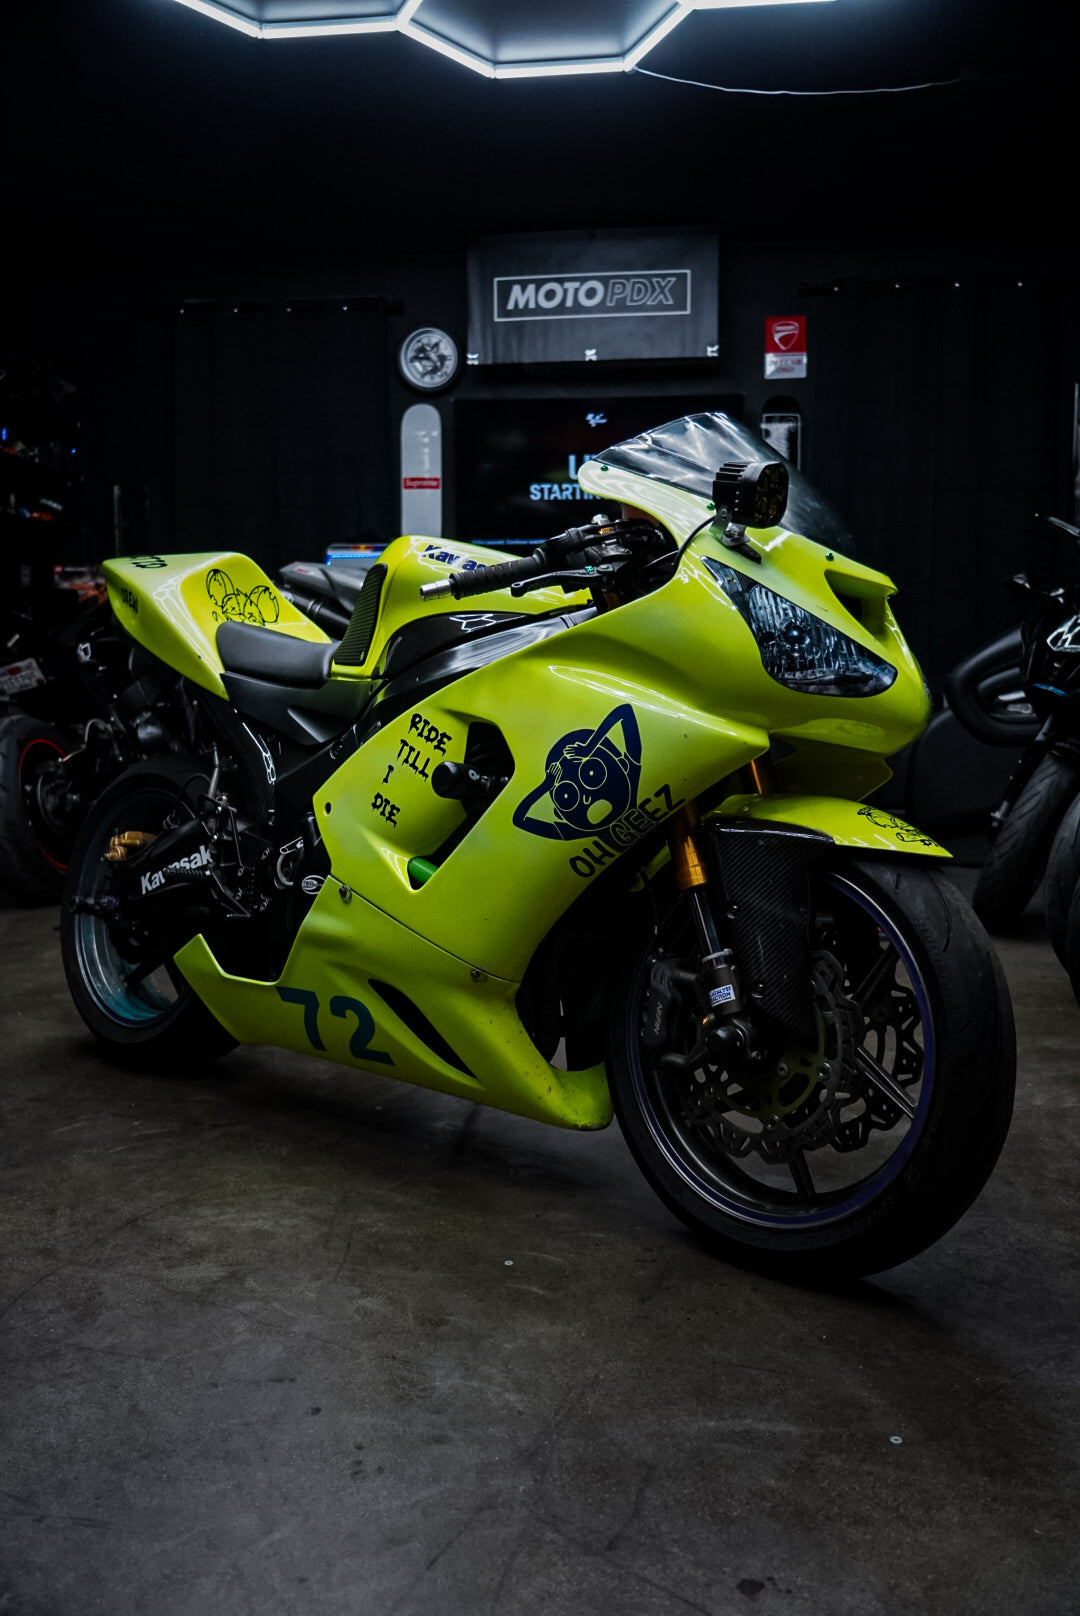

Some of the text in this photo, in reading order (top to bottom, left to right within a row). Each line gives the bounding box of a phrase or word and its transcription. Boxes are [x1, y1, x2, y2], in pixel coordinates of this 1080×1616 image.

[506, 277, 677, 310] MOTO PDX
[408, 713, 452, 756] RIDE
[382, 764, 394, 784] I
[396, 739, 430, 782] TILL
[371, 792, 401, 828] DIE
[569, 784, 686, 877] OH GEEZ
[275, 986, 396, 1067] 72
